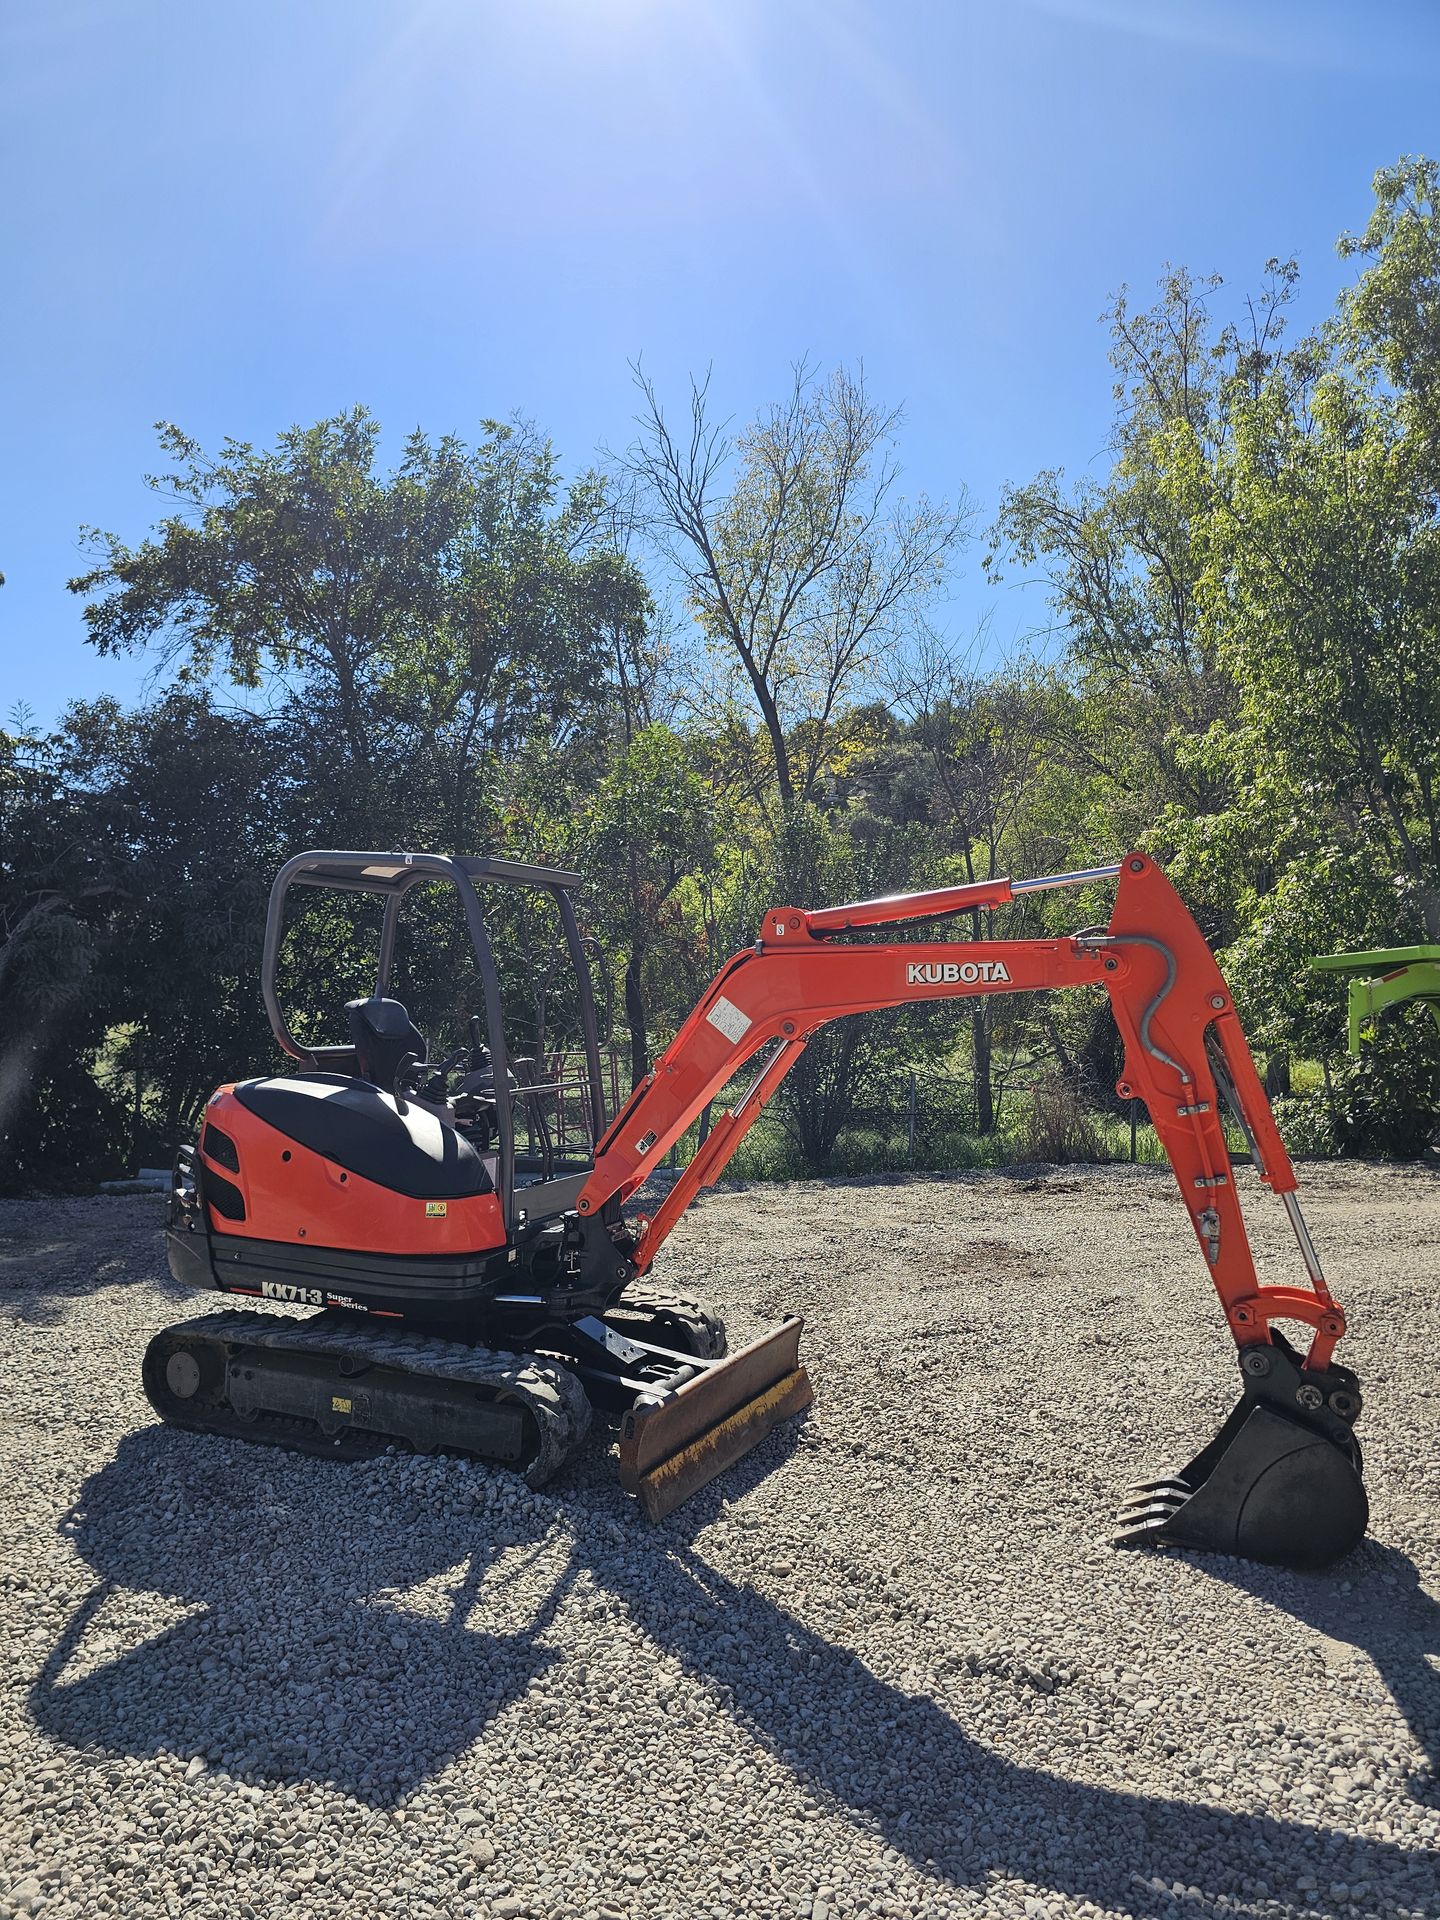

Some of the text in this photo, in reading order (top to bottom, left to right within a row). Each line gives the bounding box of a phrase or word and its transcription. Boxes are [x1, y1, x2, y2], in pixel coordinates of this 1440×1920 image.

[907, 961, 1011, 984] KUBOTA
[261, 1281, 323, 1305] KX71-3
[326, 1292, 353, 1303] Super
[340, 1300, 368, 1312] Series
